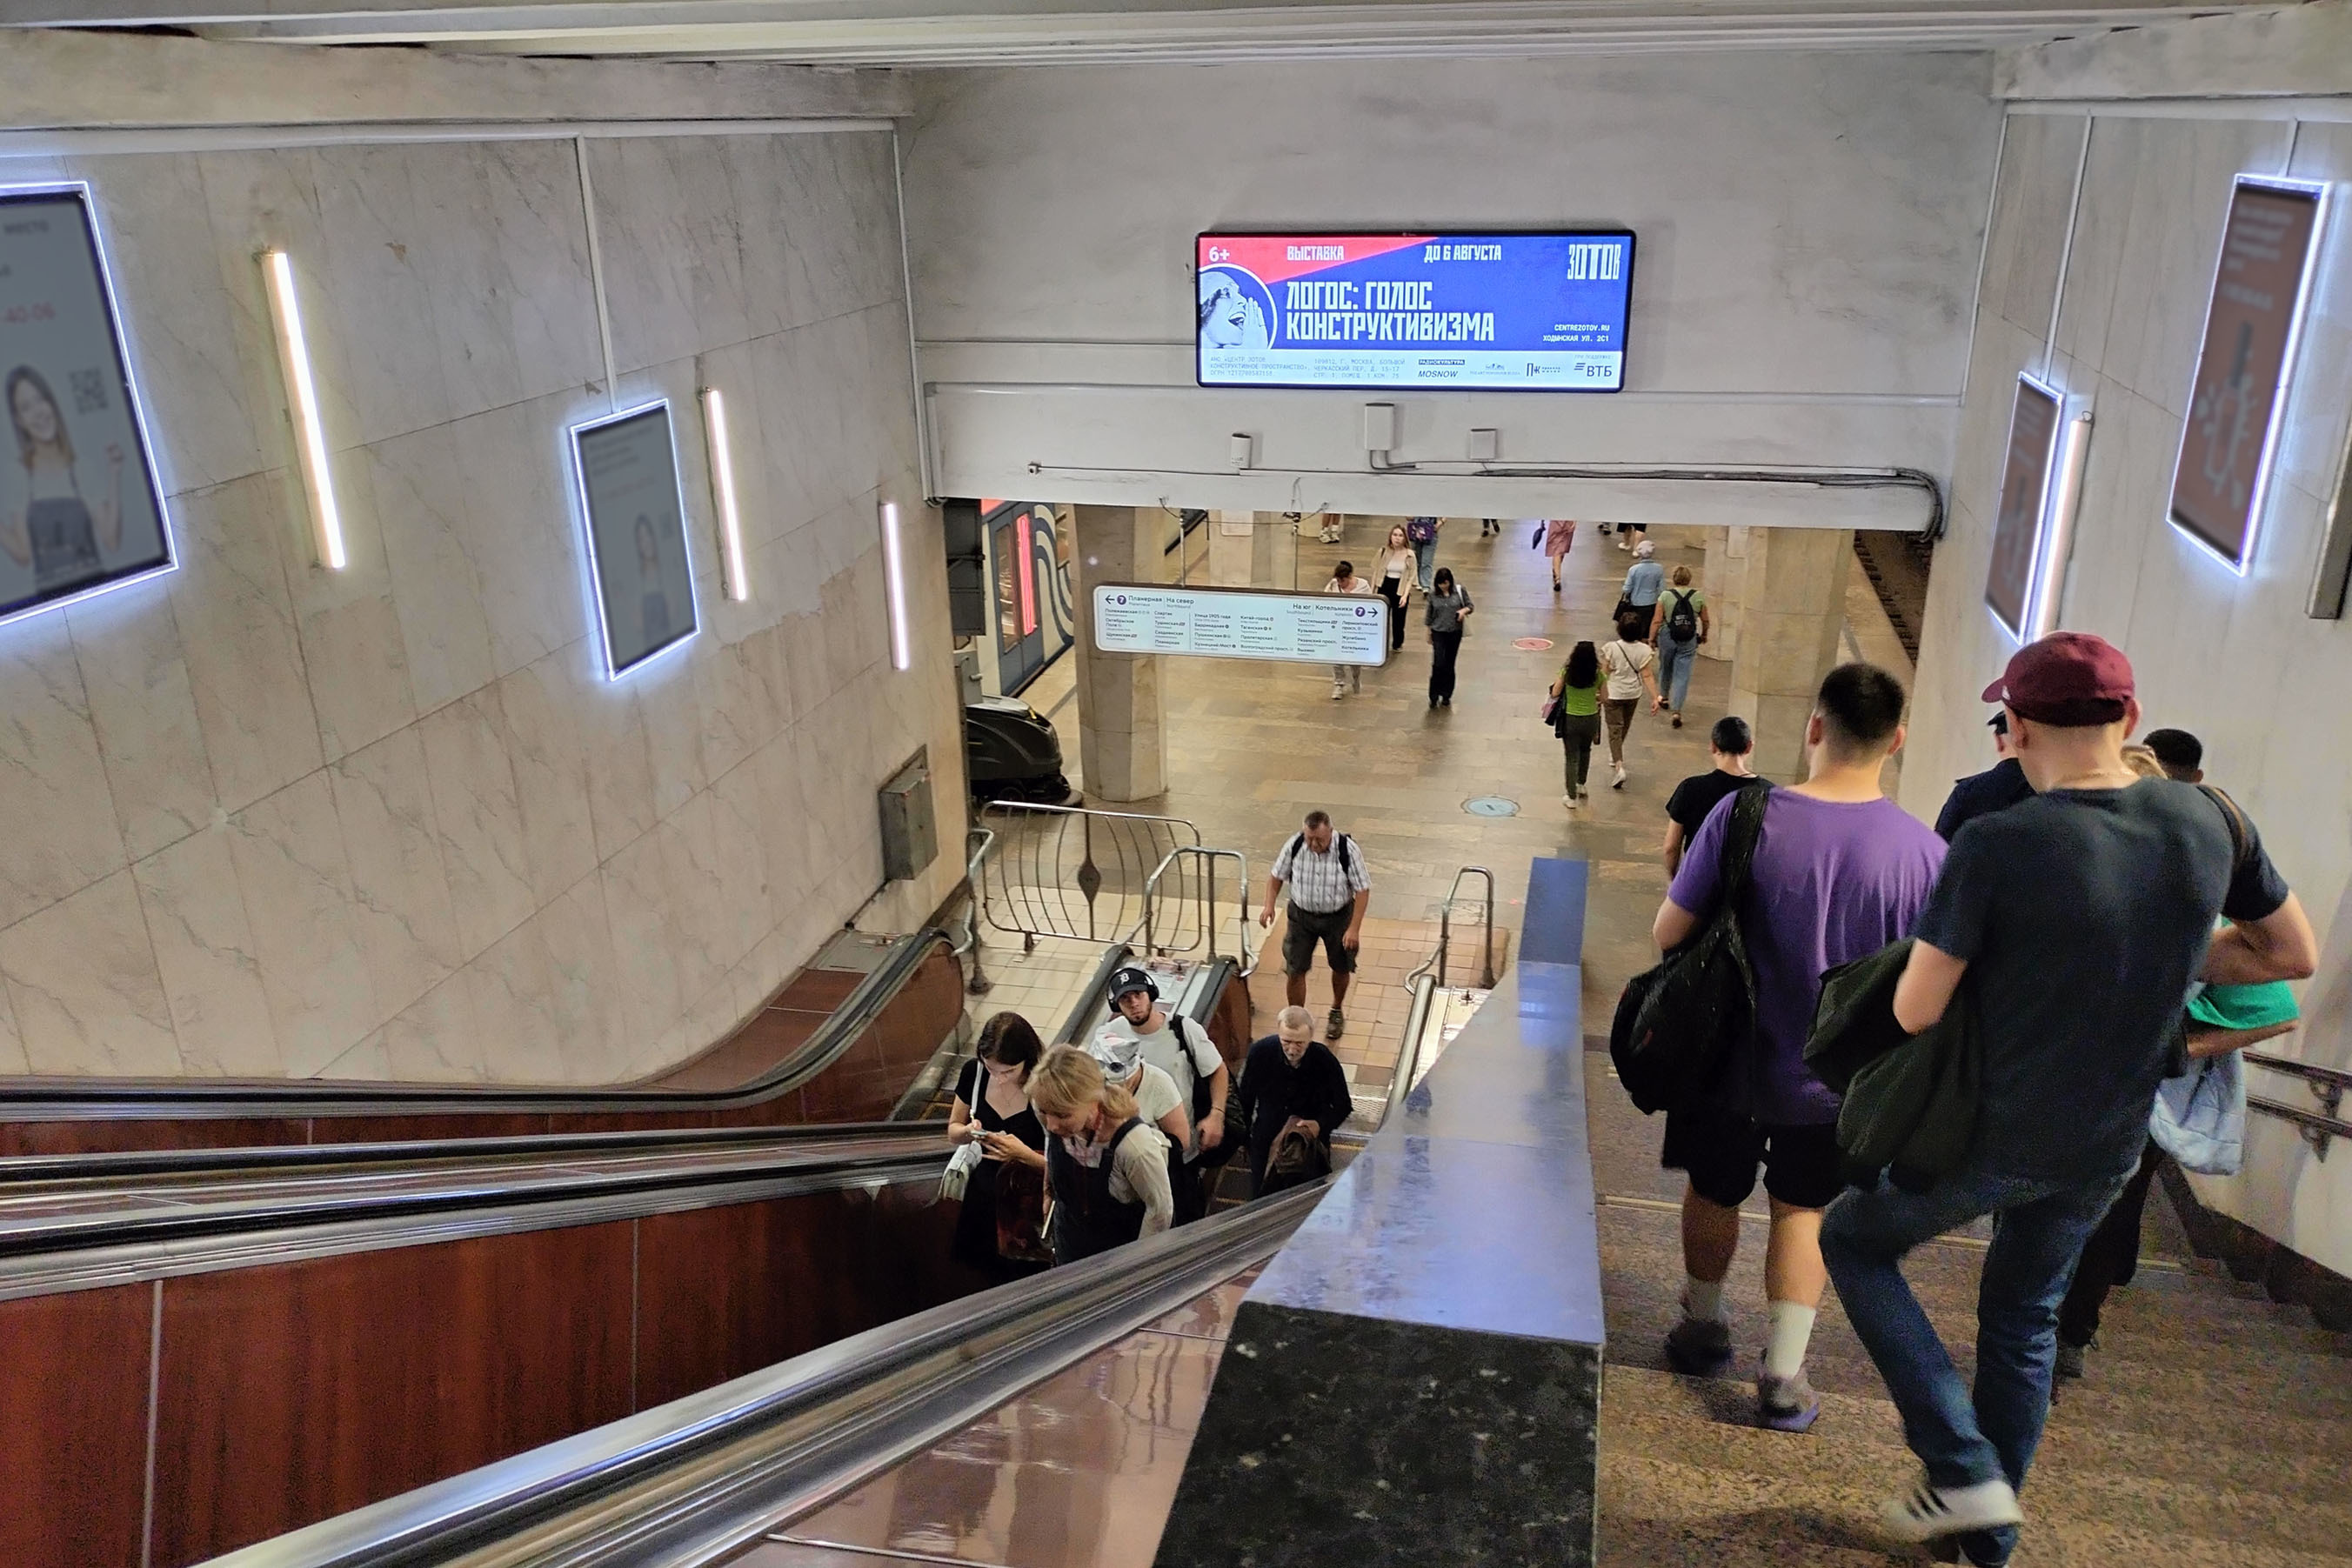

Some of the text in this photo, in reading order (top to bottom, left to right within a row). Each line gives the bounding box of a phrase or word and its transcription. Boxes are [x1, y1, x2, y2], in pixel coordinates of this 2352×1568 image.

[1208, 246, 1230, 262] 6+
[1287, 245, 1345, 261] ВЫСТАВКА
[1424, 245, 1502, 263] ДО 6 АВГУСТА
[1567, 244, 1621, 280] ЗОТОВ
[1286, 281, 1433, 310] ЛОГОС: ГОЛОС
[1286, 311, 1495, 342] КОНСТРУКТИВИЗМА
[1587, 365, 1614, 377] ВТБ
